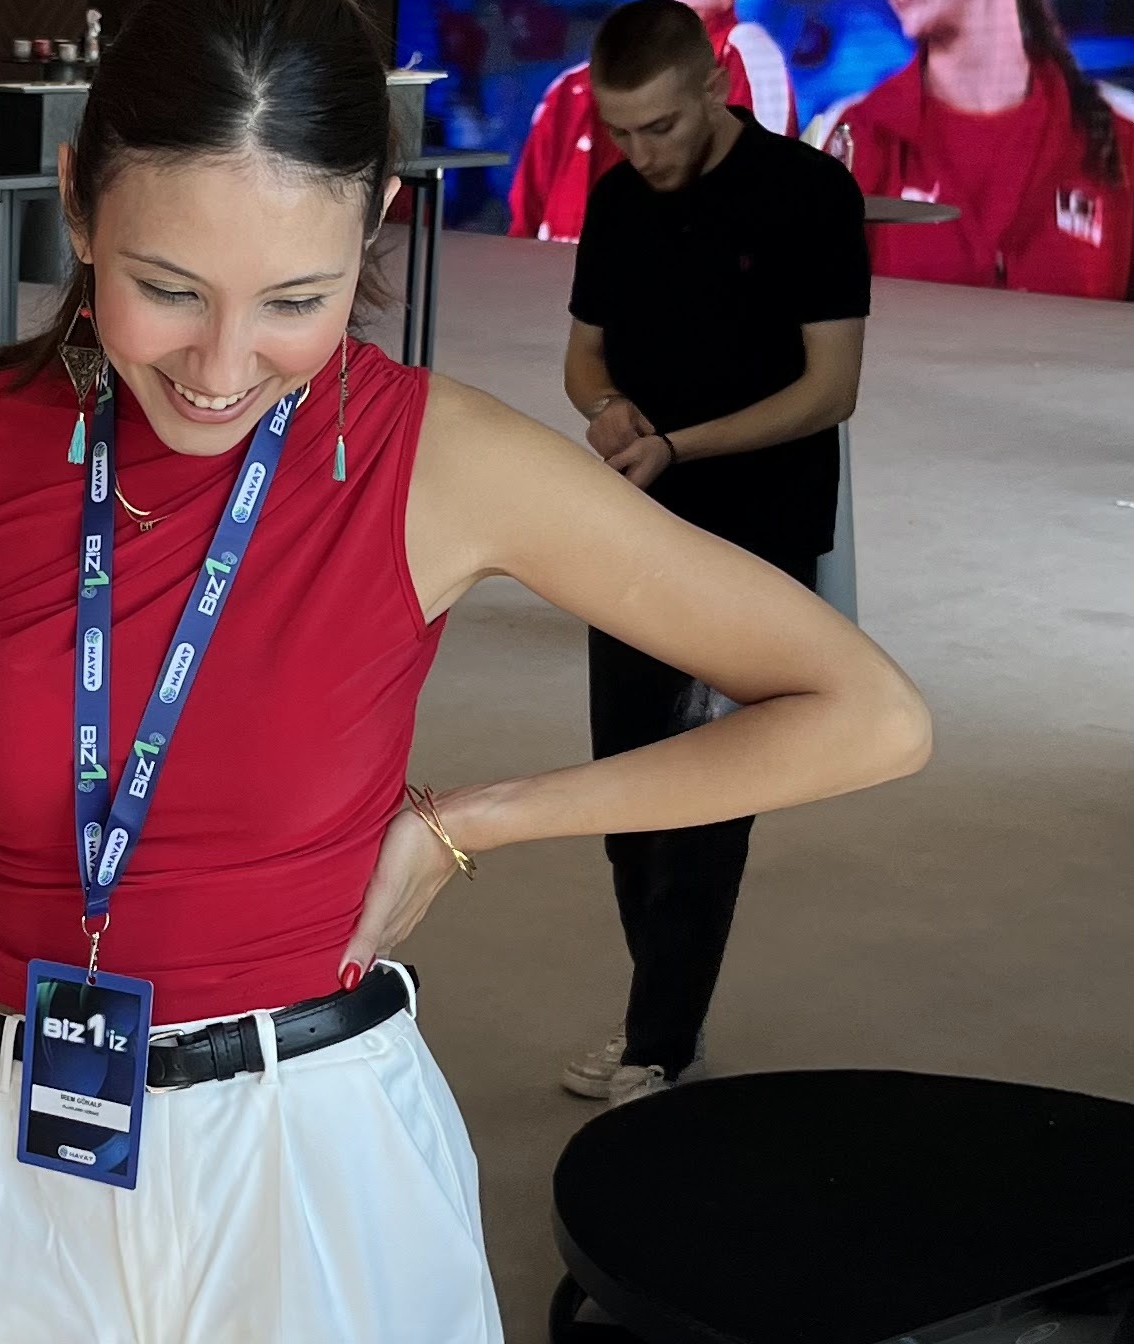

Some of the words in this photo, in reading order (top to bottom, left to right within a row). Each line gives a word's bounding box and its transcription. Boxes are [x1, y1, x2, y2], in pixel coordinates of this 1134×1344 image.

[94, 459, 103, 500] HAYAT
[242, 467, 263, 506] HAYAT
[87, 646, 96, 687] HAYAT
[171, 646, 191, 687] HAYAT
[106, 831, 125, 869] HAYAT
[69, 1151, 94, 1162] HAYAT
